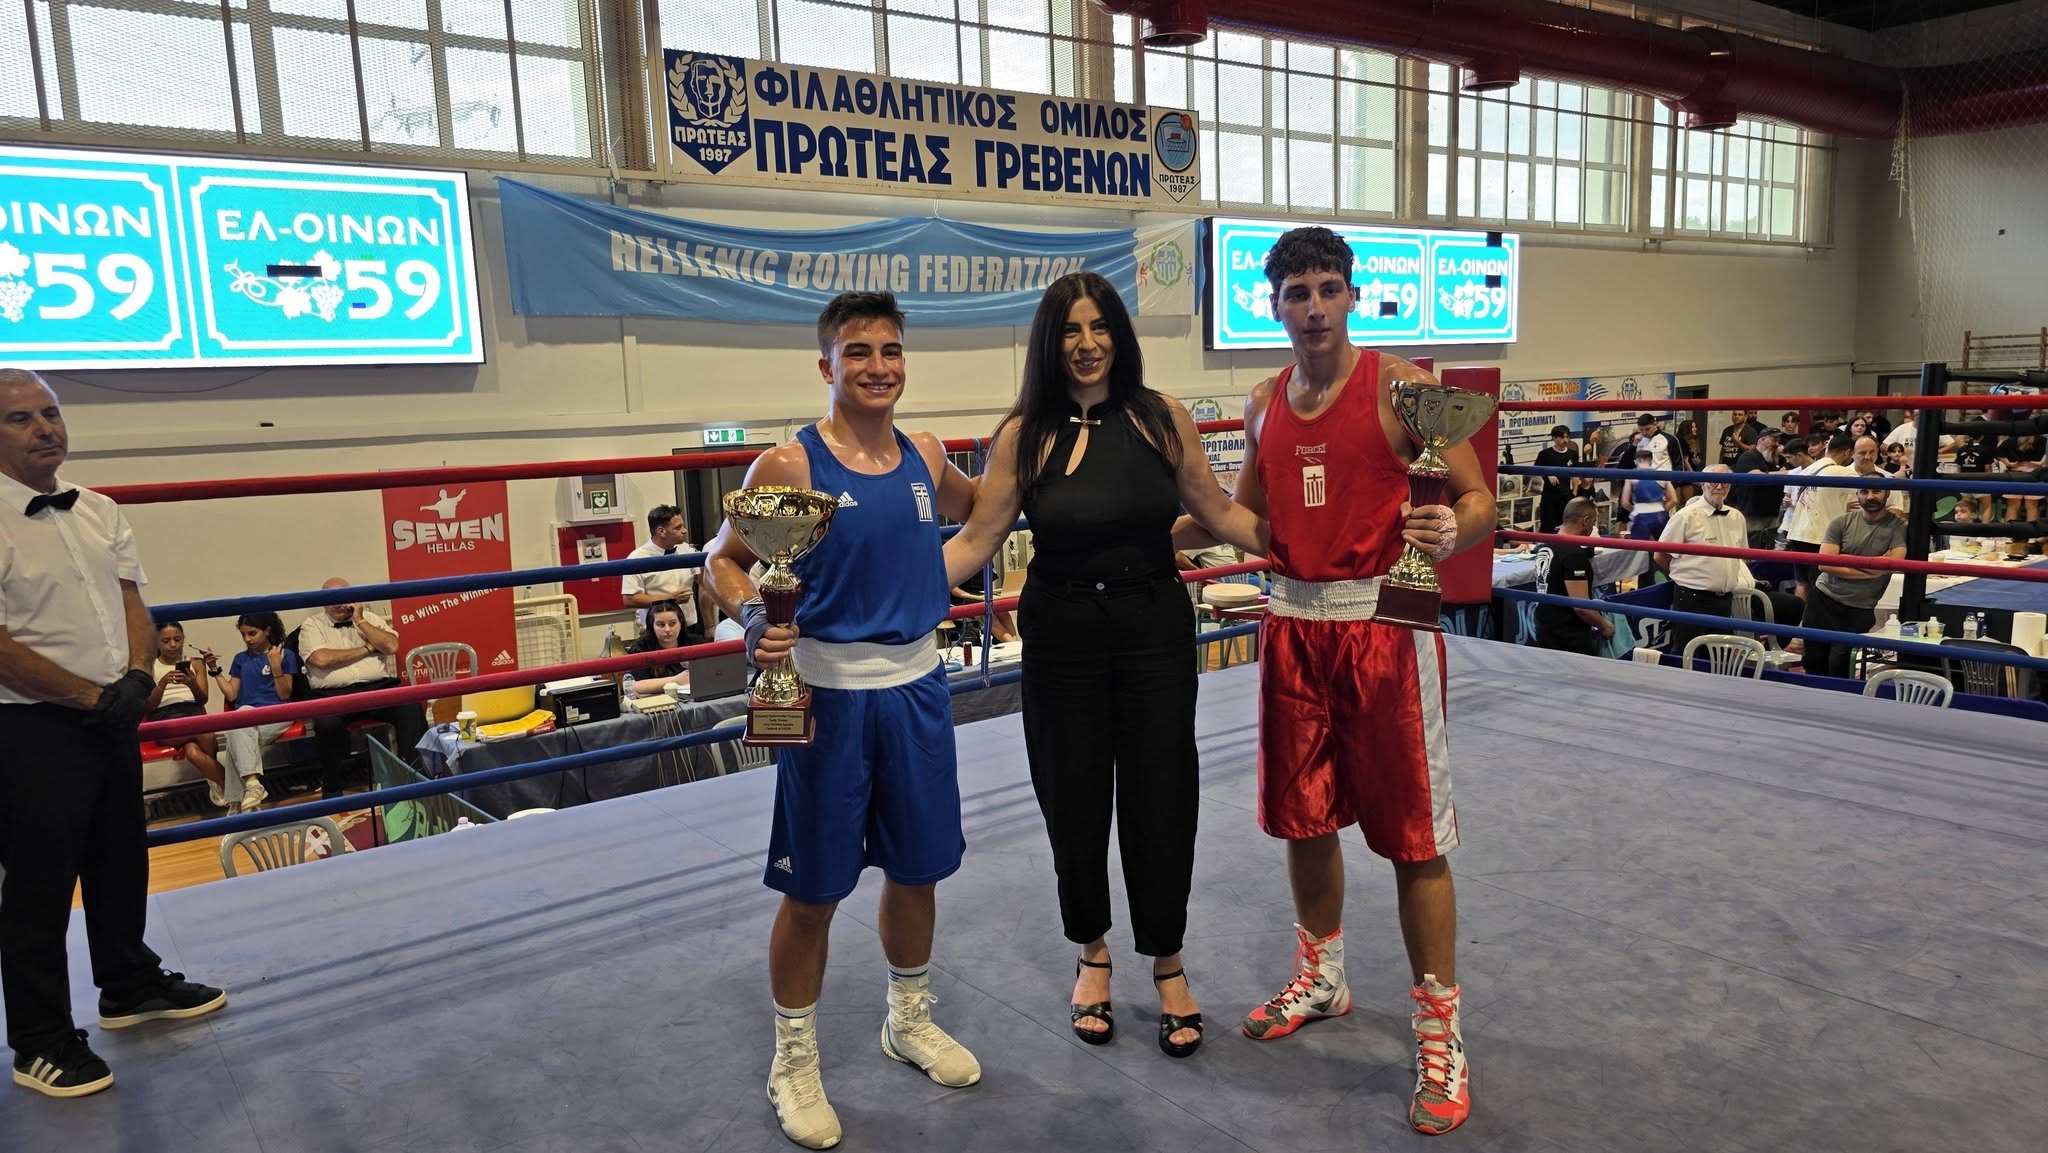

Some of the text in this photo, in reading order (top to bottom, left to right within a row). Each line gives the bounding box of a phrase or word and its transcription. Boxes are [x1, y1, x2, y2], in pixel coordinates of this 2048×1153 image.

[754, 67, 1147, 142] ΦΙΛΑΘΛΗΤΙΚΟΣ ΟΜΙΛΟΣ
[674, 126, 747, 147] ΠΡΩΤΕΑΣ
[699, 148, 732, 162] 1987
[754, 119, 1150, 197] ΠΡΩΤΕΑΣ ΓΡΕΒΕΝΩΝ
[1159, 174, 1195, 185] ΠΡΩΤΕΑΣ
[1169, 184, 1187, 193] 1987
[0, 201, 152, 238] ΙΝΩΝ
[216, 209, 439, 246] ΕΛ-ΟΙΝΩΝ
[610, 230, 779, 286] HELLENIC
[788, 251, 911, 294] BOXING
[1438, 258, 1508, 276] ΕΛ-ΟΙΝΩΝ
[33, 252, 154, 321] 59
[344, 259, 441, 320] 59
[1473, 284, 1507, 319] 59
[1538, 382, 1564, 396] ΓΡΕΒΕΝΑ
[839, 500, 858, 508] didas
[392, 512, 504, 550] SEVEN
[427, 541, 475, 553] HELLAS
[401, 614, 415, 624] Be
[416, 604, 440, 619] With
[440, 596, 459, 610] The
[491, 658, 515, 667] adidas
